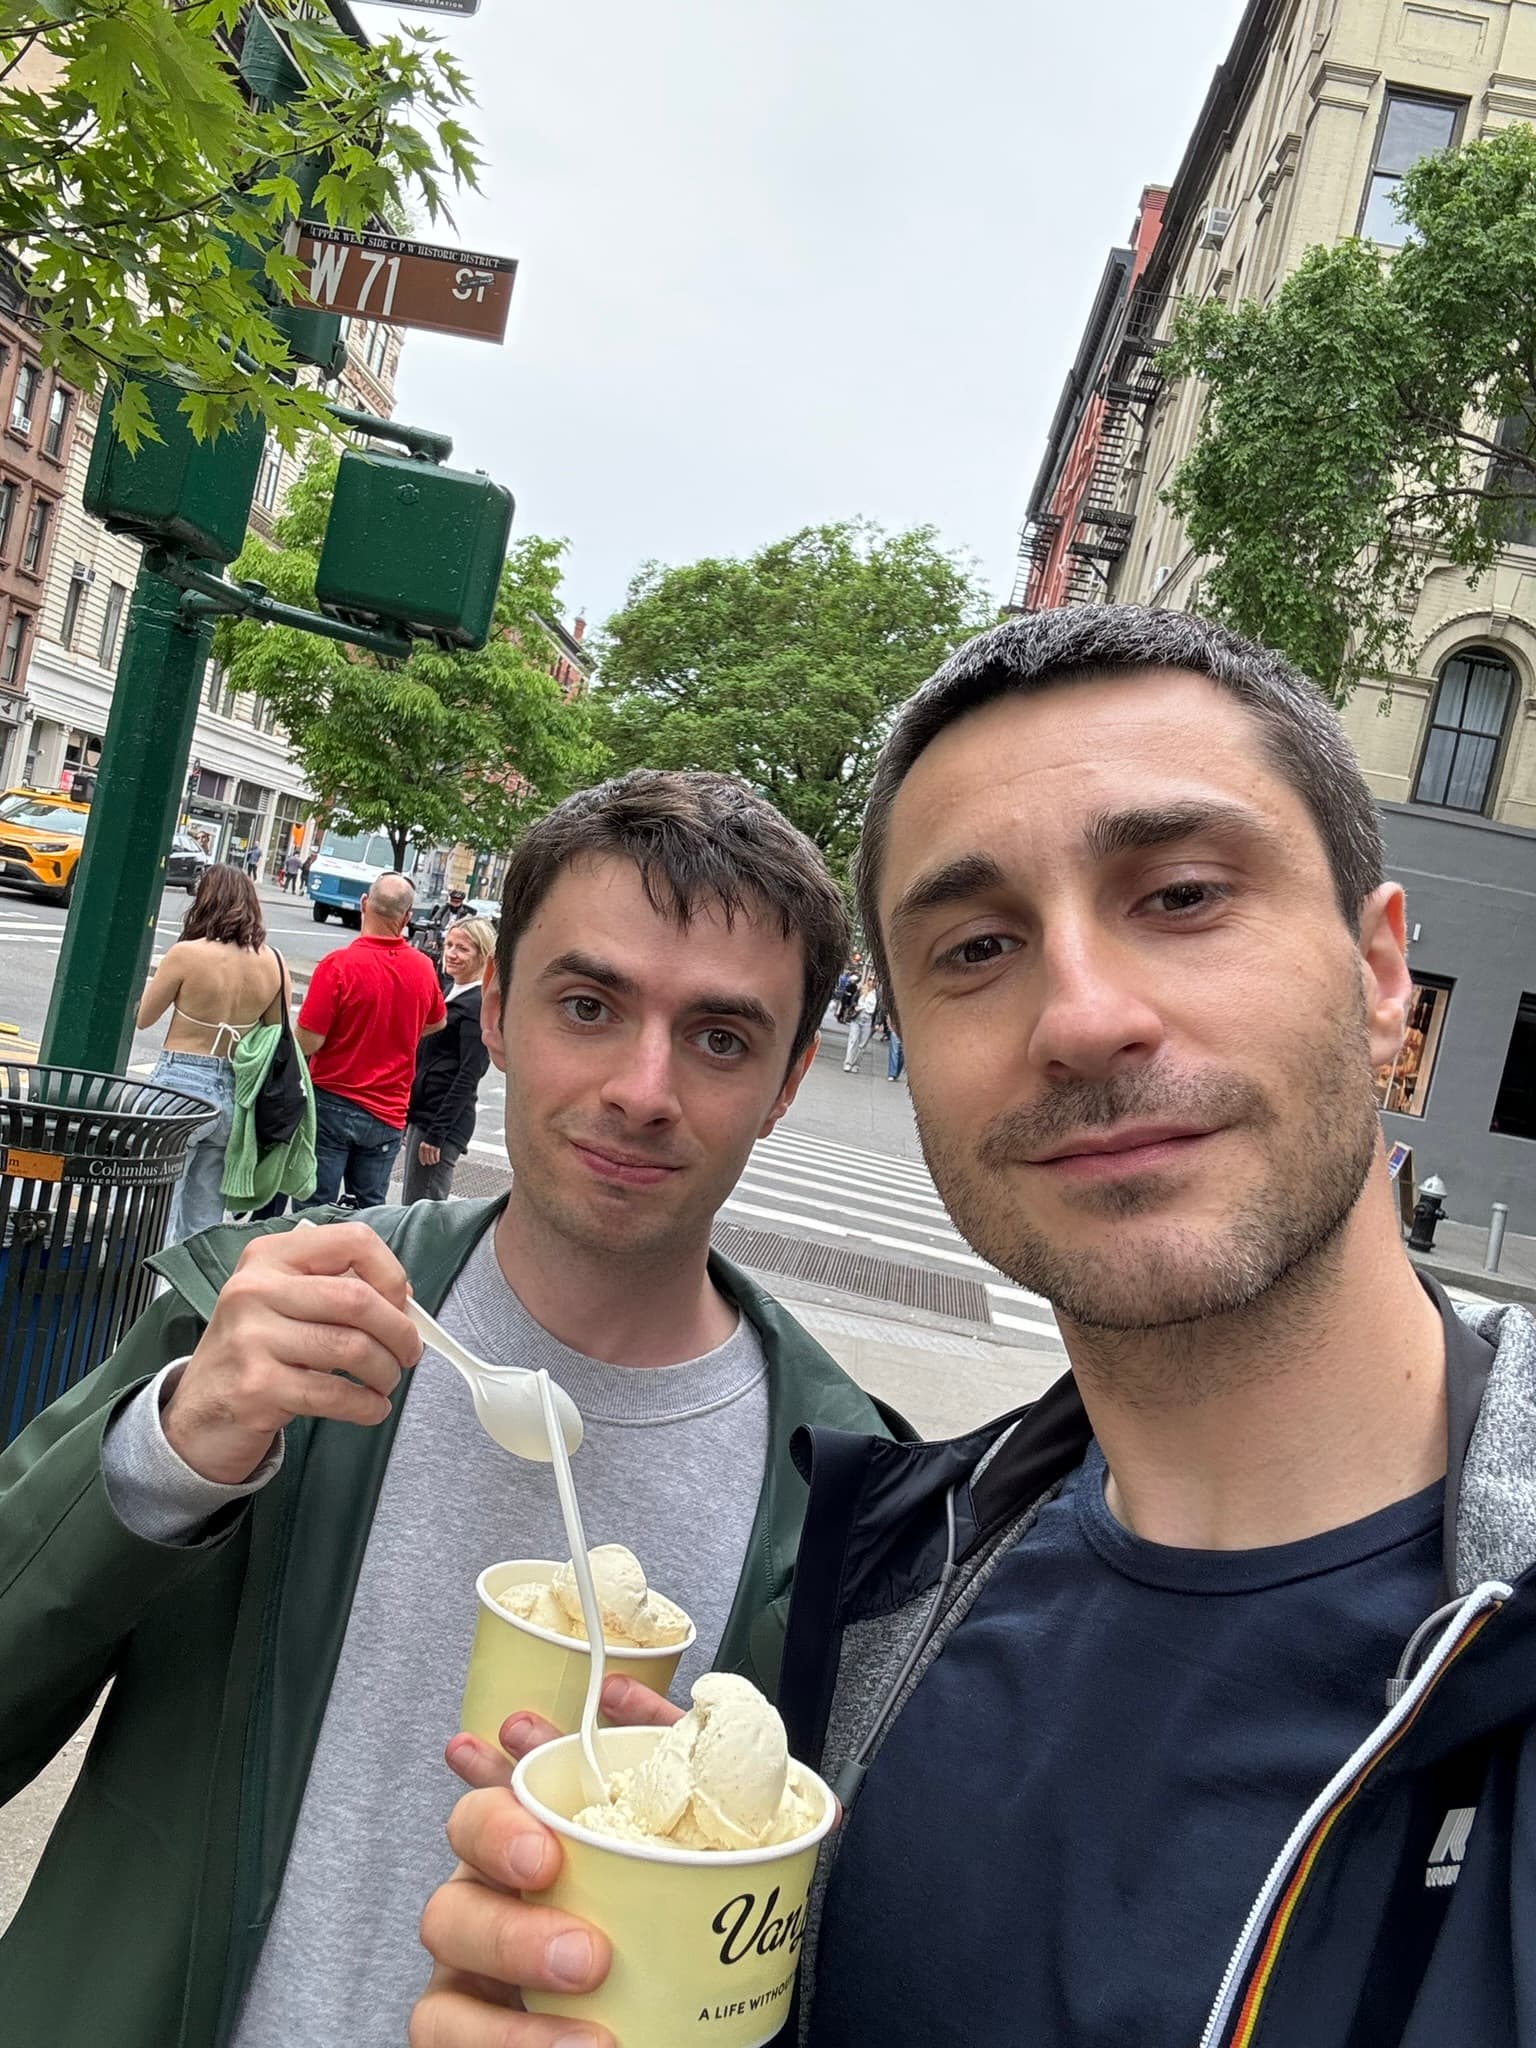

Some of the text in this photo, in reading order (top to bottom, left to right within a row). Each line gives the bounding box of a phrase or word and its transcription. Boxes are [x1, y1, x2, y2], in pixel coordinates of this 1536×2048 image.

[311, 226, 500, 269] UPPER WET SIDE C P W HISTORIC DISTRICT
[310, 241, 494, 316] W 71 ST
[89, 1160, 159, 1177] Columbus
[64, 1175, 118, 1185] BUSINESS
[698, 2007, 710, 2021] A
[715, 2001, 746, 2020] LIFE
